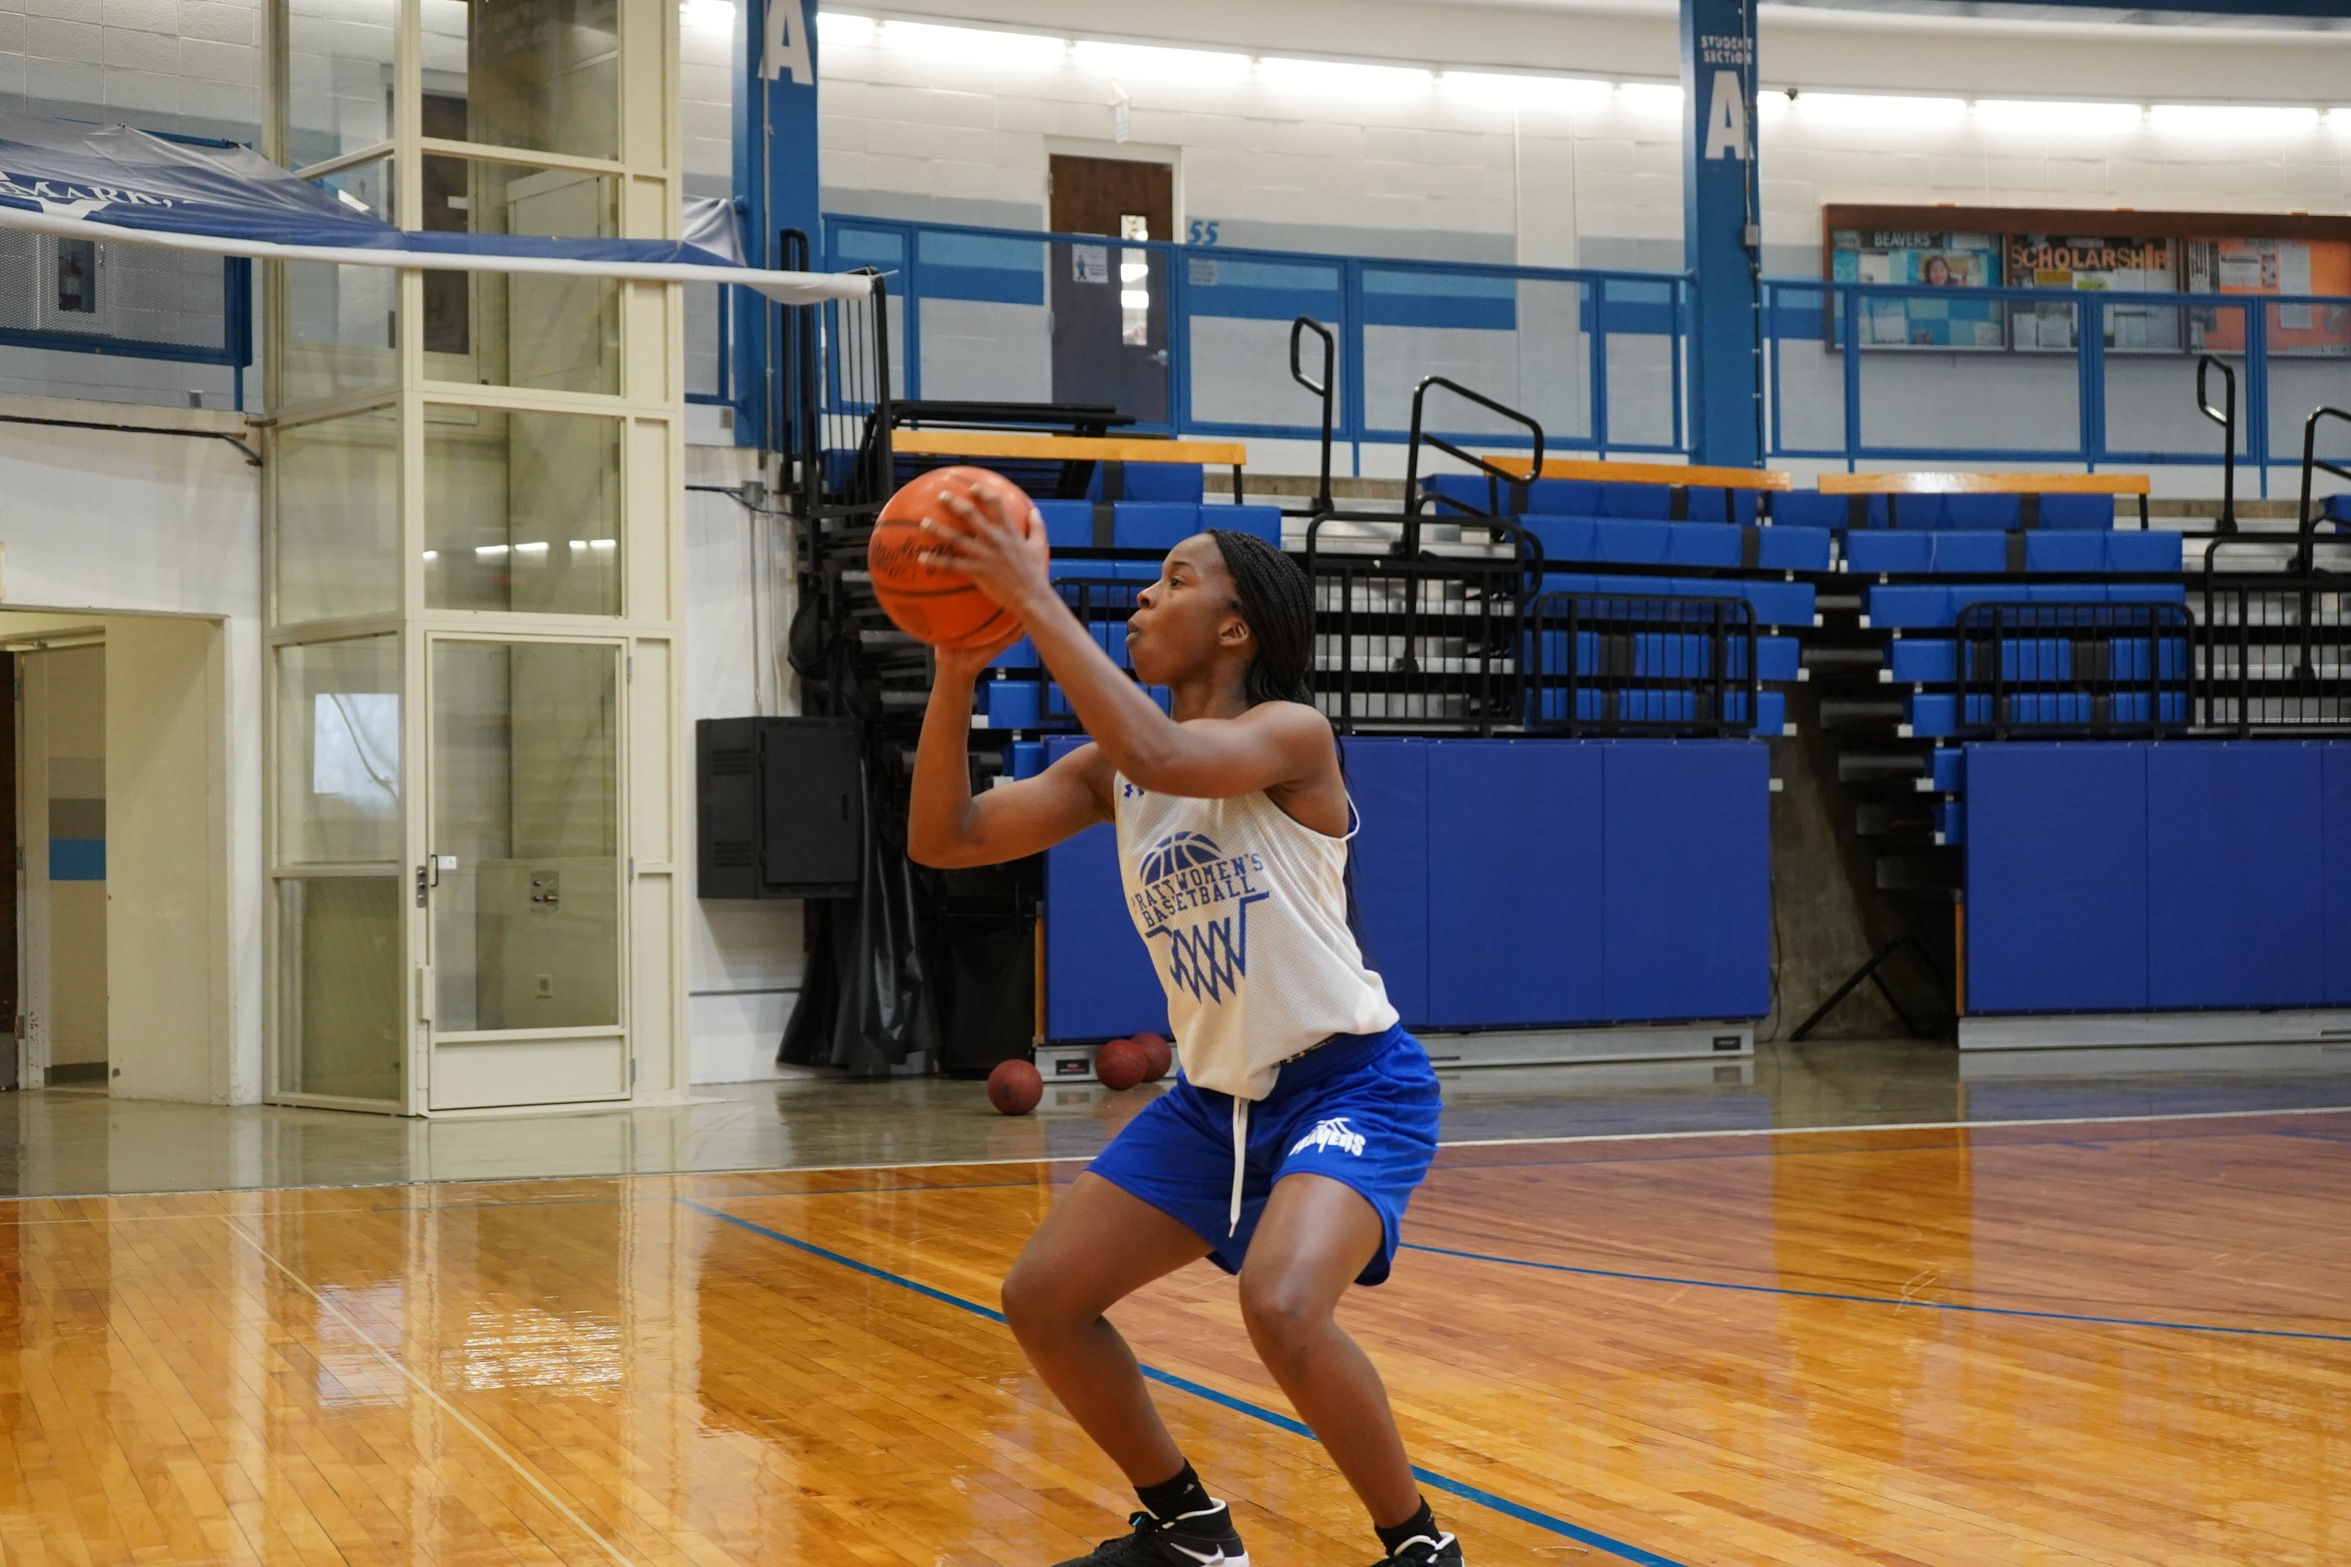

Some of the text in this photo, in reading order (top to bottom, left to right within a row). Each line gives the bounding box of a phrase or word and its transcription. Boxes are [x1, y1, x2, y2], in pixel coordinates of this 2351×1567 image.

[757, 0, 814, 86] A
[1703, 50, 1753, 65] SECTION
[1705, 70, 1755, 160] A
[1189, 220, 1220, 245] 55
[1874, 231, 1931, 248] BEAVERS
[1176, 853, 1263, 891] WOMEN'S
[1142, 876, 1256, 928] BASETBALL
